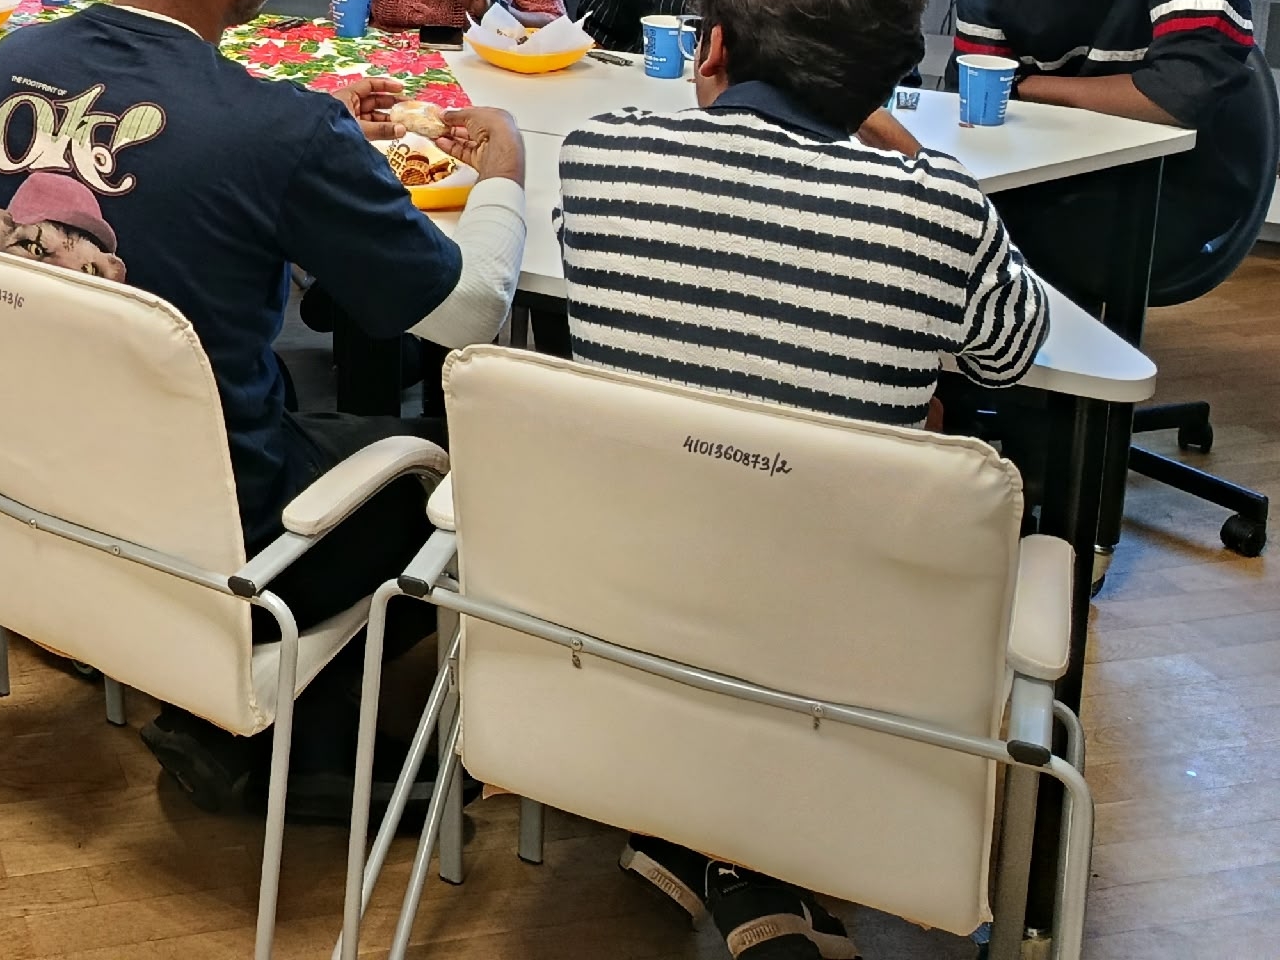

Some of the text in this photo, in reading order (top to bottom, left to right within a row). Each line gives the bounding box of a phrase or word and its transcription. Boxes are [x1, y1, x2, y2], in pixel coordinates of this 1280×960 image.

[12, 76, 22, 84] THE
[22, 78, 58, 93] FOOTPRINT
[683, 436, 792, 476] 4101360873/2
